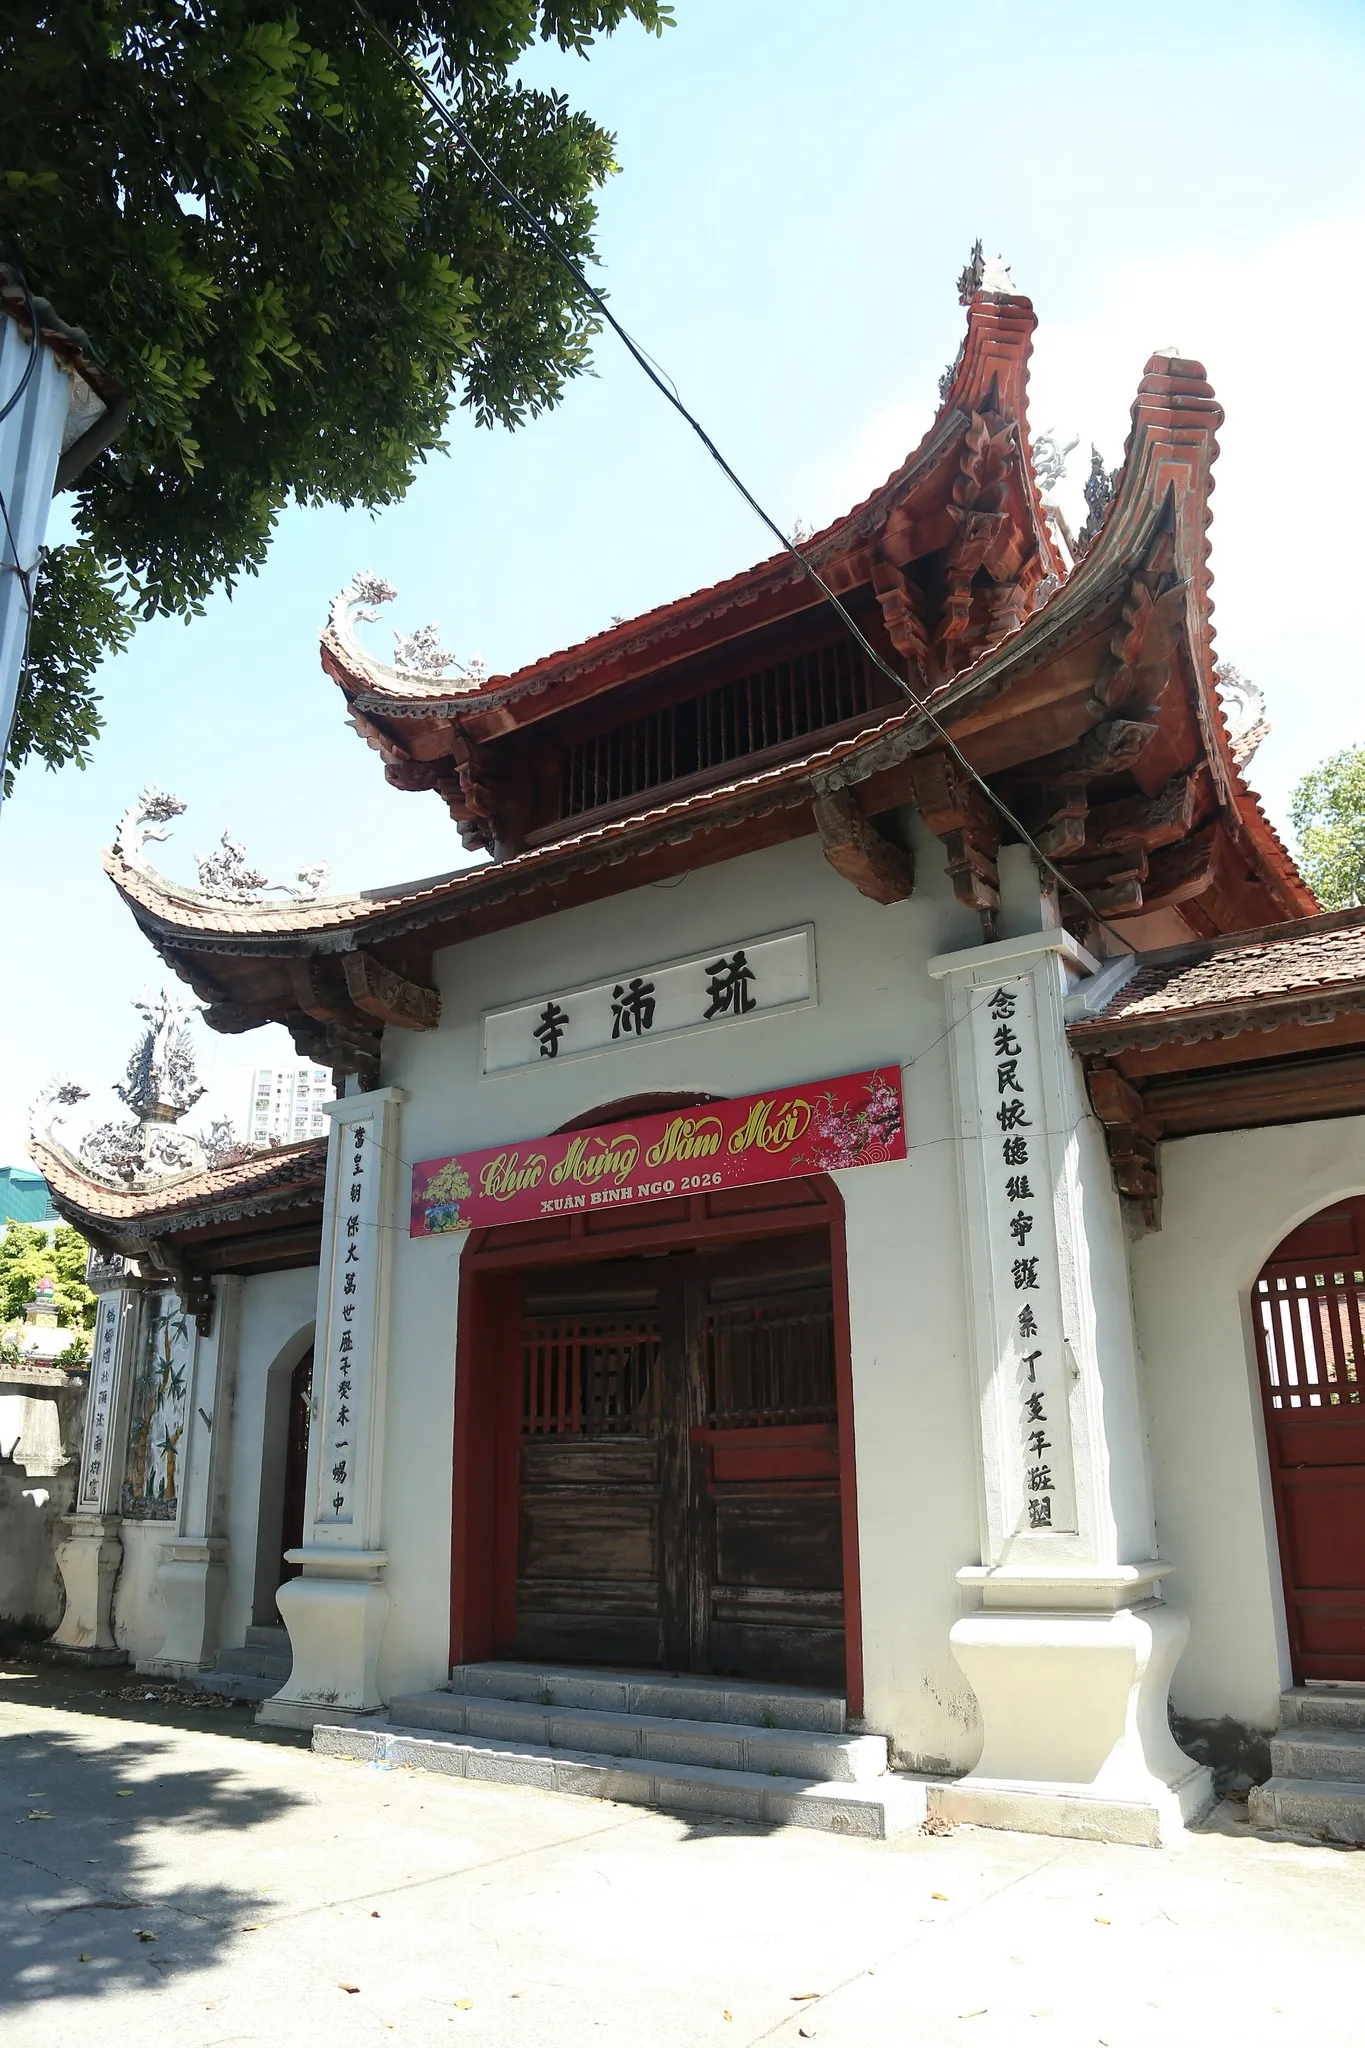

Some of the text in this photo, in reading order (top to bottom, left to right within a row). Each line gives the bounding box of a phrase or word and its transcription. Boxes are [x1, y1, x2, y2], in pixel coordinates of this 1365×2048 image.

[479, 1099, 811, 1202] Chúc Mừng Năm Mới
[540, 1171, 722, 1213] XUÂN BÍNH NGỌ 2026
